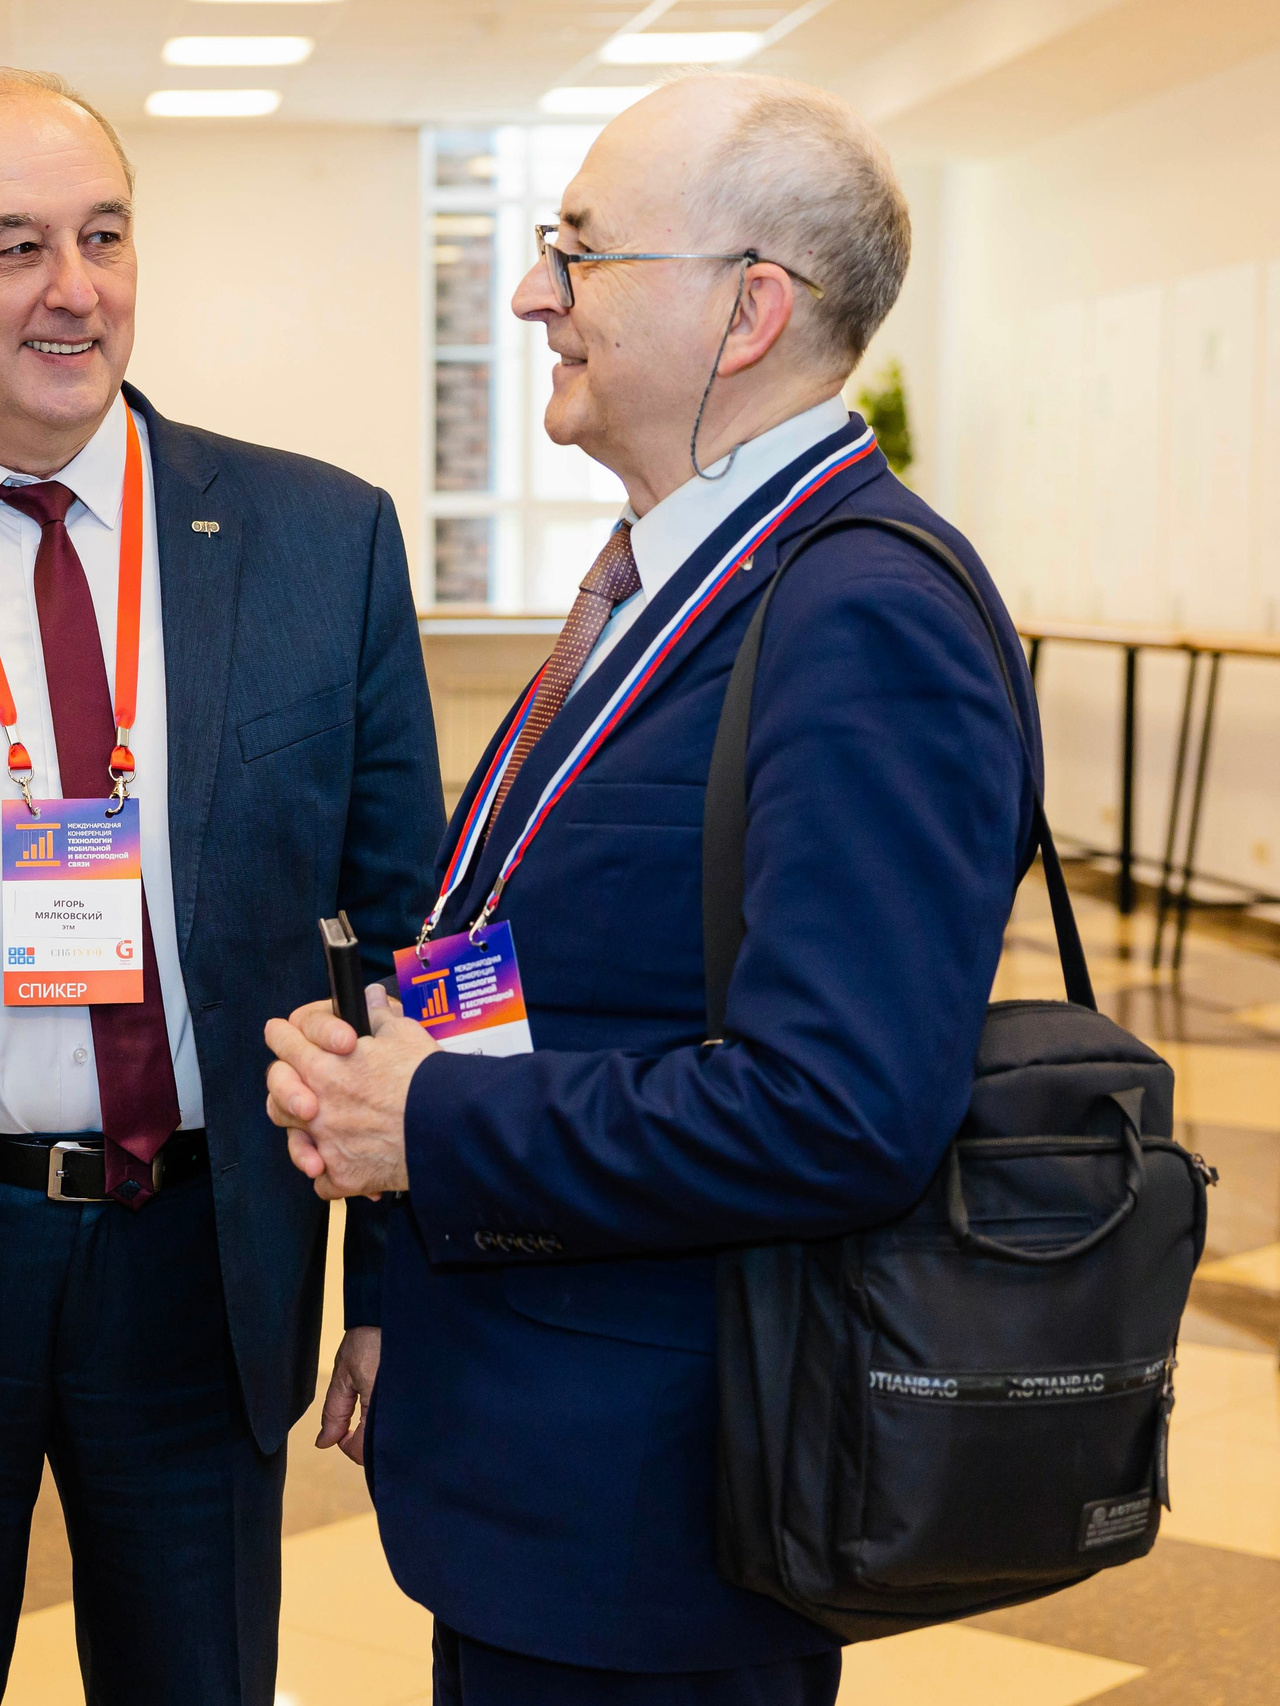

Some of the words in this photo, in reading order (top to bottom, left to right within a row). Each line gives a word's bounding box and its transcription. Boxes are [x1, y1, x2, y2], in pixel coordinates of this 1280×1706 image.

[67, 844, 111, 852] МОБИЛЬНОЙ
[74, 851, 129, 860] БЕСПРОВОДНОЙ
[53, 900, 85, 908] ИГОРЬ
[34, 911, 103, 920] МЯЛКОВСКИЙ
[17, 982, 88, 999] СПИКЕР
